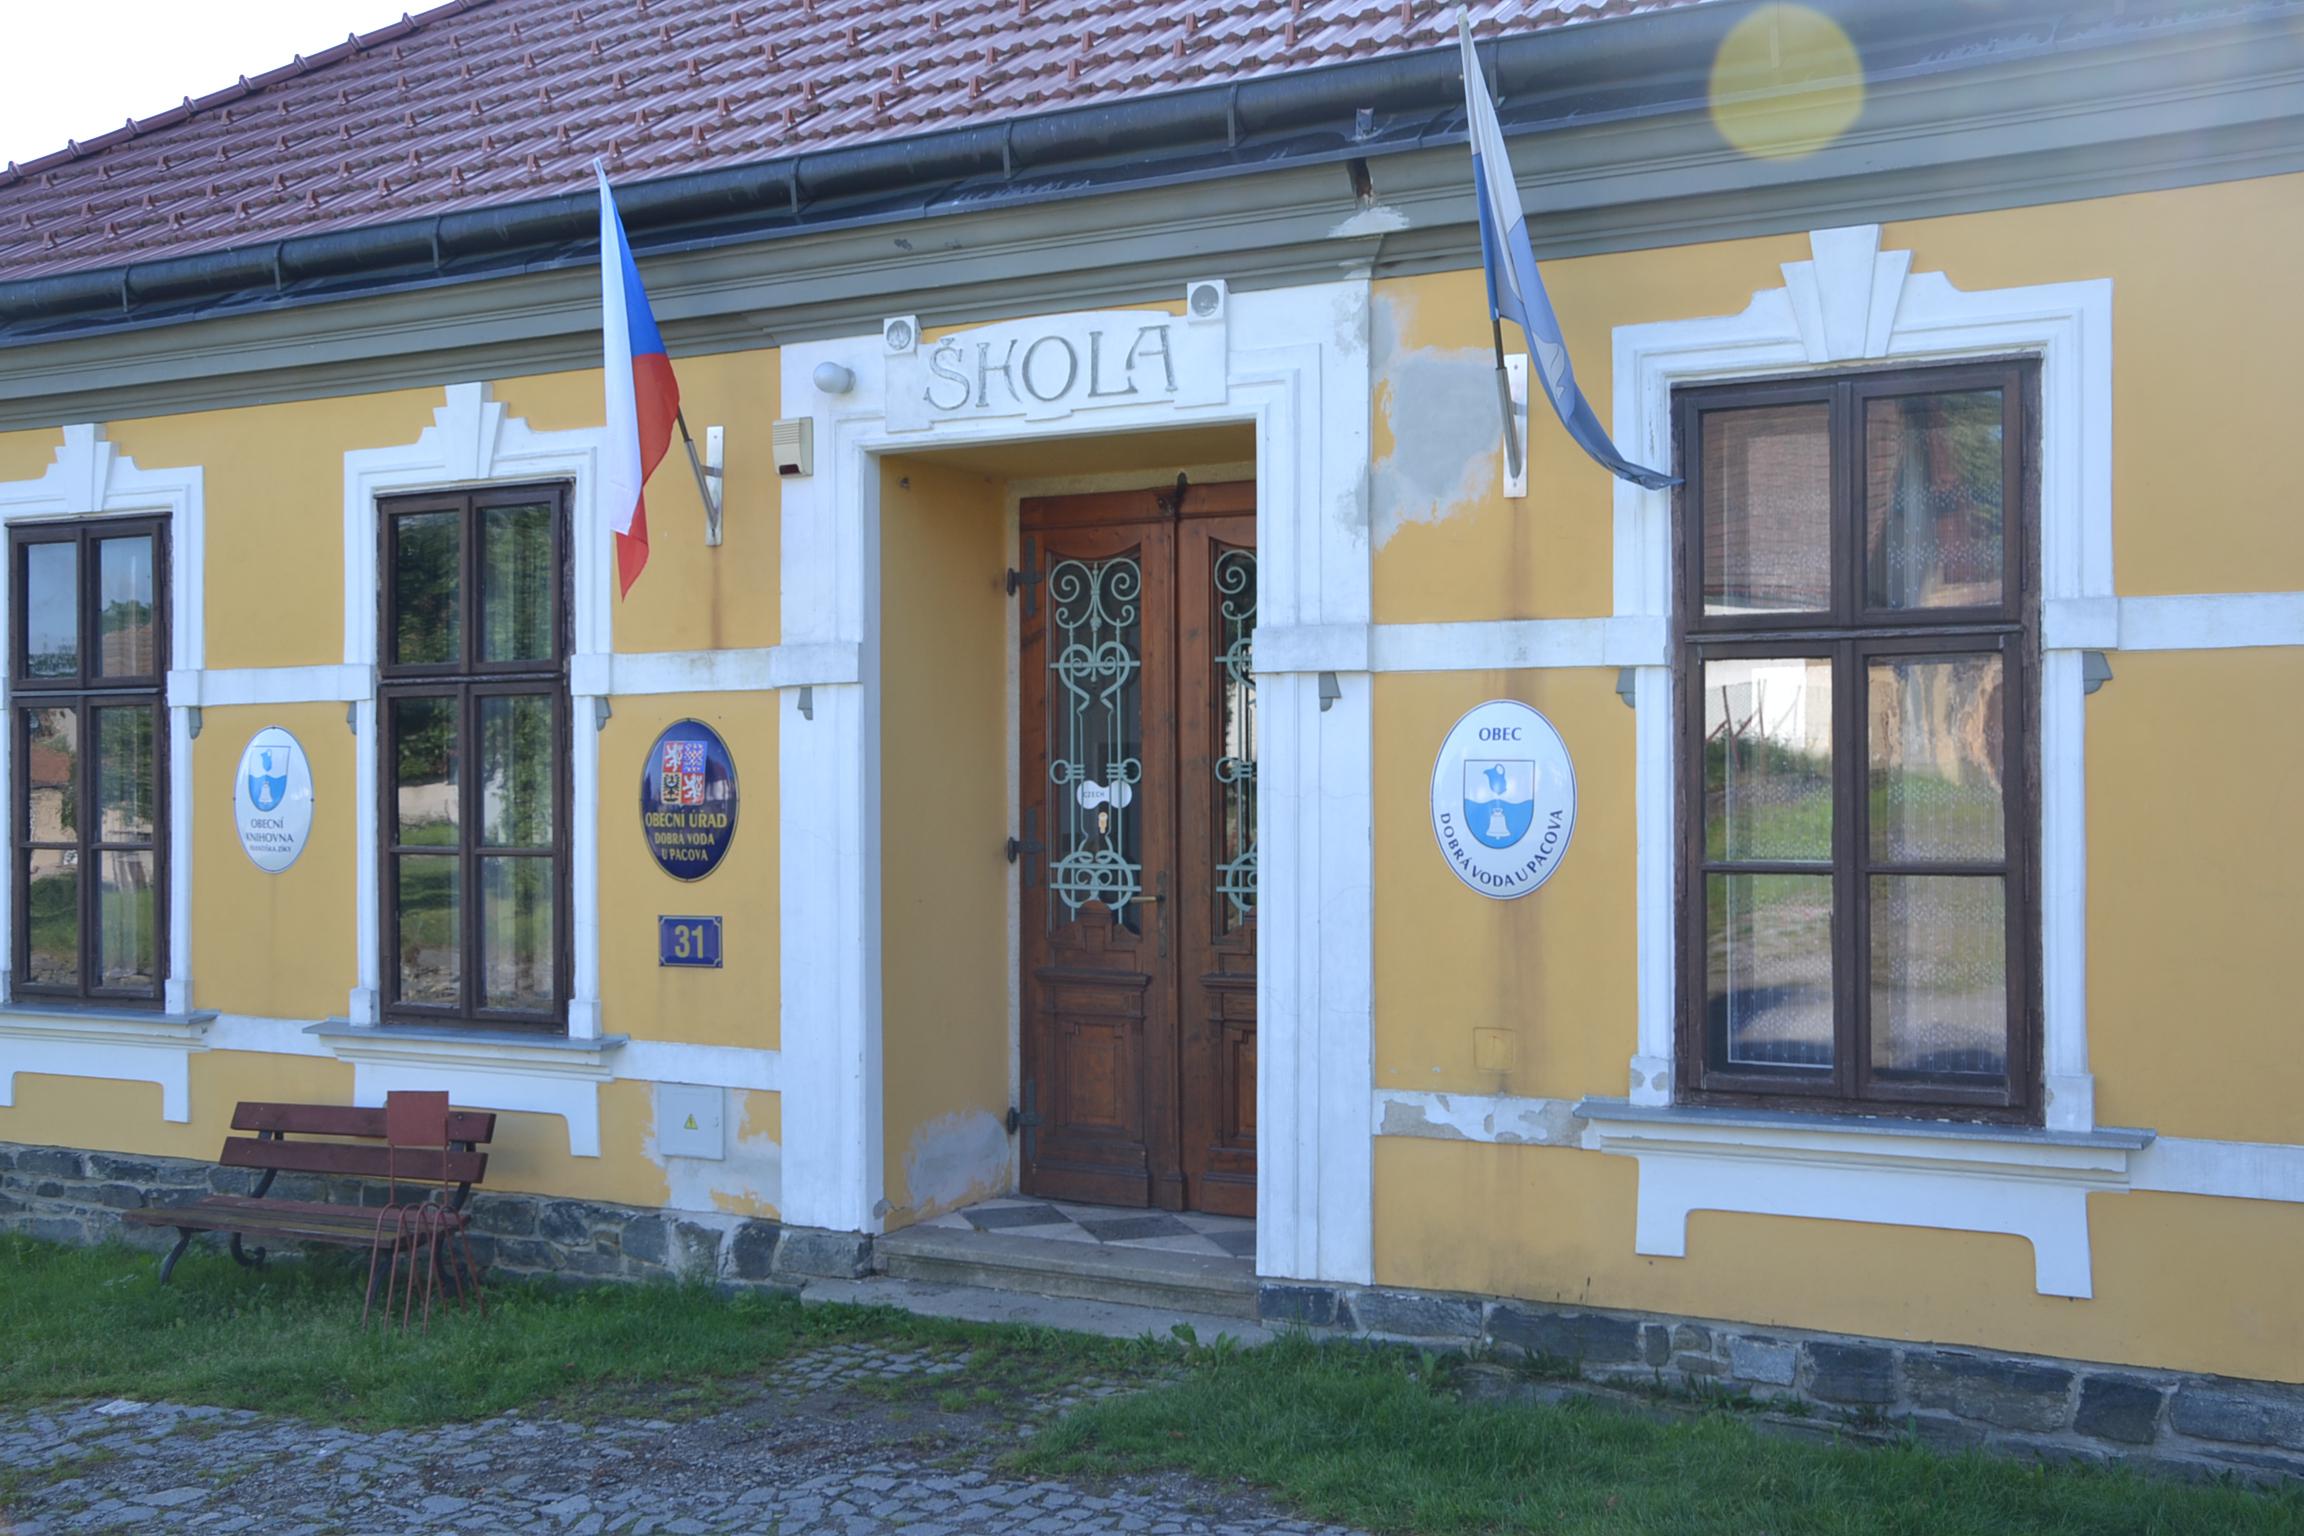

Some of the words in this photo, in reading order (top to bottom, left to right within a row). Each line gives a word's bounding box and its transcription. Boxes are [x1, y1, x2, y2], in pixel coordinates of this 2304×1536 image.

[923, 324, 1178, 411] ŠKOLA
[1479, 727, 1522, 741] OBEC
[250, 816, 284, 829] OBECNÍ
[645, 810, 686, 828] OBECNÍ
[689, 809, 728, 828] ÚŘAD
[245, 831, 294, 843] KNIHOVNA
[654, 830, 685, 845] DOBRÁ
[687, 832, 715, 845] VODA
[661, 849, 668, 860] U
[669, 848, 709, 861] PACOVA
[1440, 812, 1472, 871] DOBRÁ
[1472, 865, 1516, 887] VODA
[1514, 868, 1529, 882] U
[1526, 809, 1563, 873] PACOVA
[674, 924, 704, 959] 31
